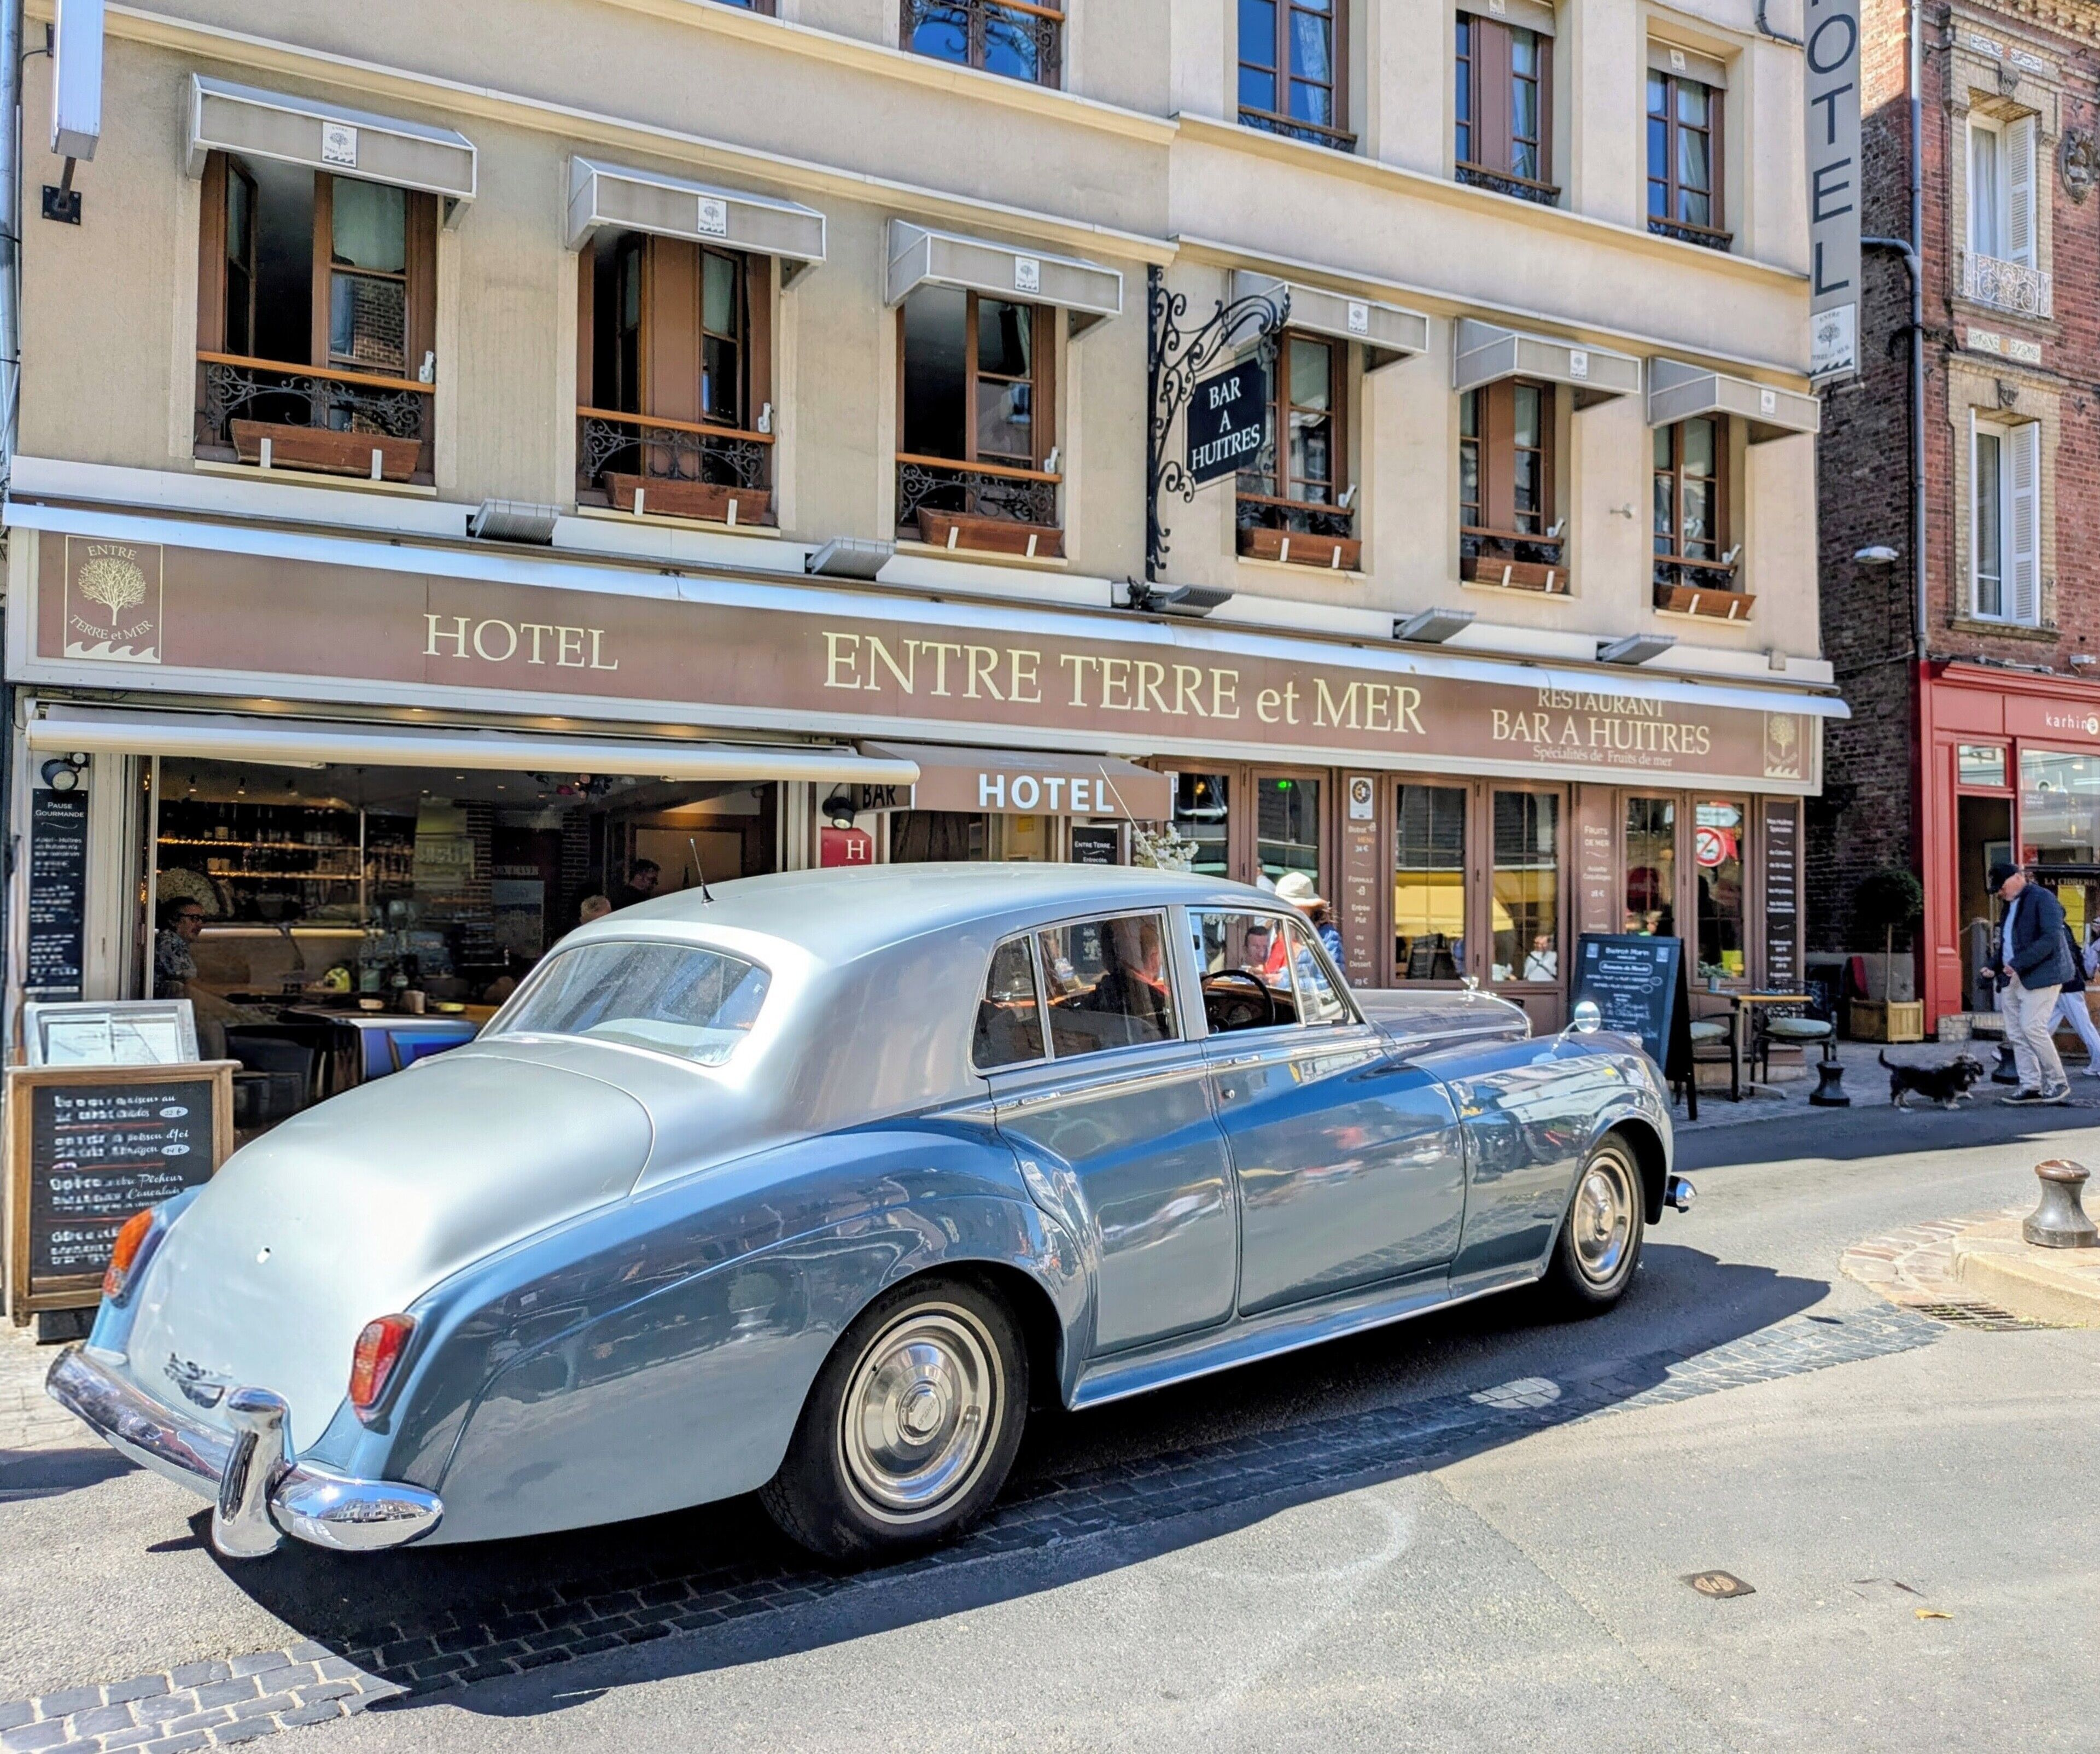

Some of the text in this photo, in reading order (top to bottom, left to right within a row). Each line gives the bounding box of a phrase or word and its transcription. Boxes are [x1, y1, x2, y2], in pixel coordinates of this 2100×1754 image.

[1807, 0, 1857, 296] OTEL
[1209, 376, 1241, 410] BAR
[1219, 409, 1232, 434] A
[1191, 423, 1261, 471] HUITRES
[87, 545, 137, 560] ENTRE
[69, 614, 153, 640] TERRE et MER
[422, 613, 619, 671] HOTEL
[822, 631, 1426, 735] ENTRE TERRE et MER
[1538, 687, 1663, 717] RESTAURANT
[1491, 709, 1711, 755] BAR A HUITRES
[1589, 749, 1603, 761] de
[1608, 750, 1636, 764] Fruits
[1638, 753, 1652, 765] de
[1654, 756, 1673, 766] mer
[862, 784, 896, 809] BAR
[978, 773, 1114, 813] HOTEL
[36, 809, 84, 818] GOURMANDE
[845, 839, 866, 860] H
